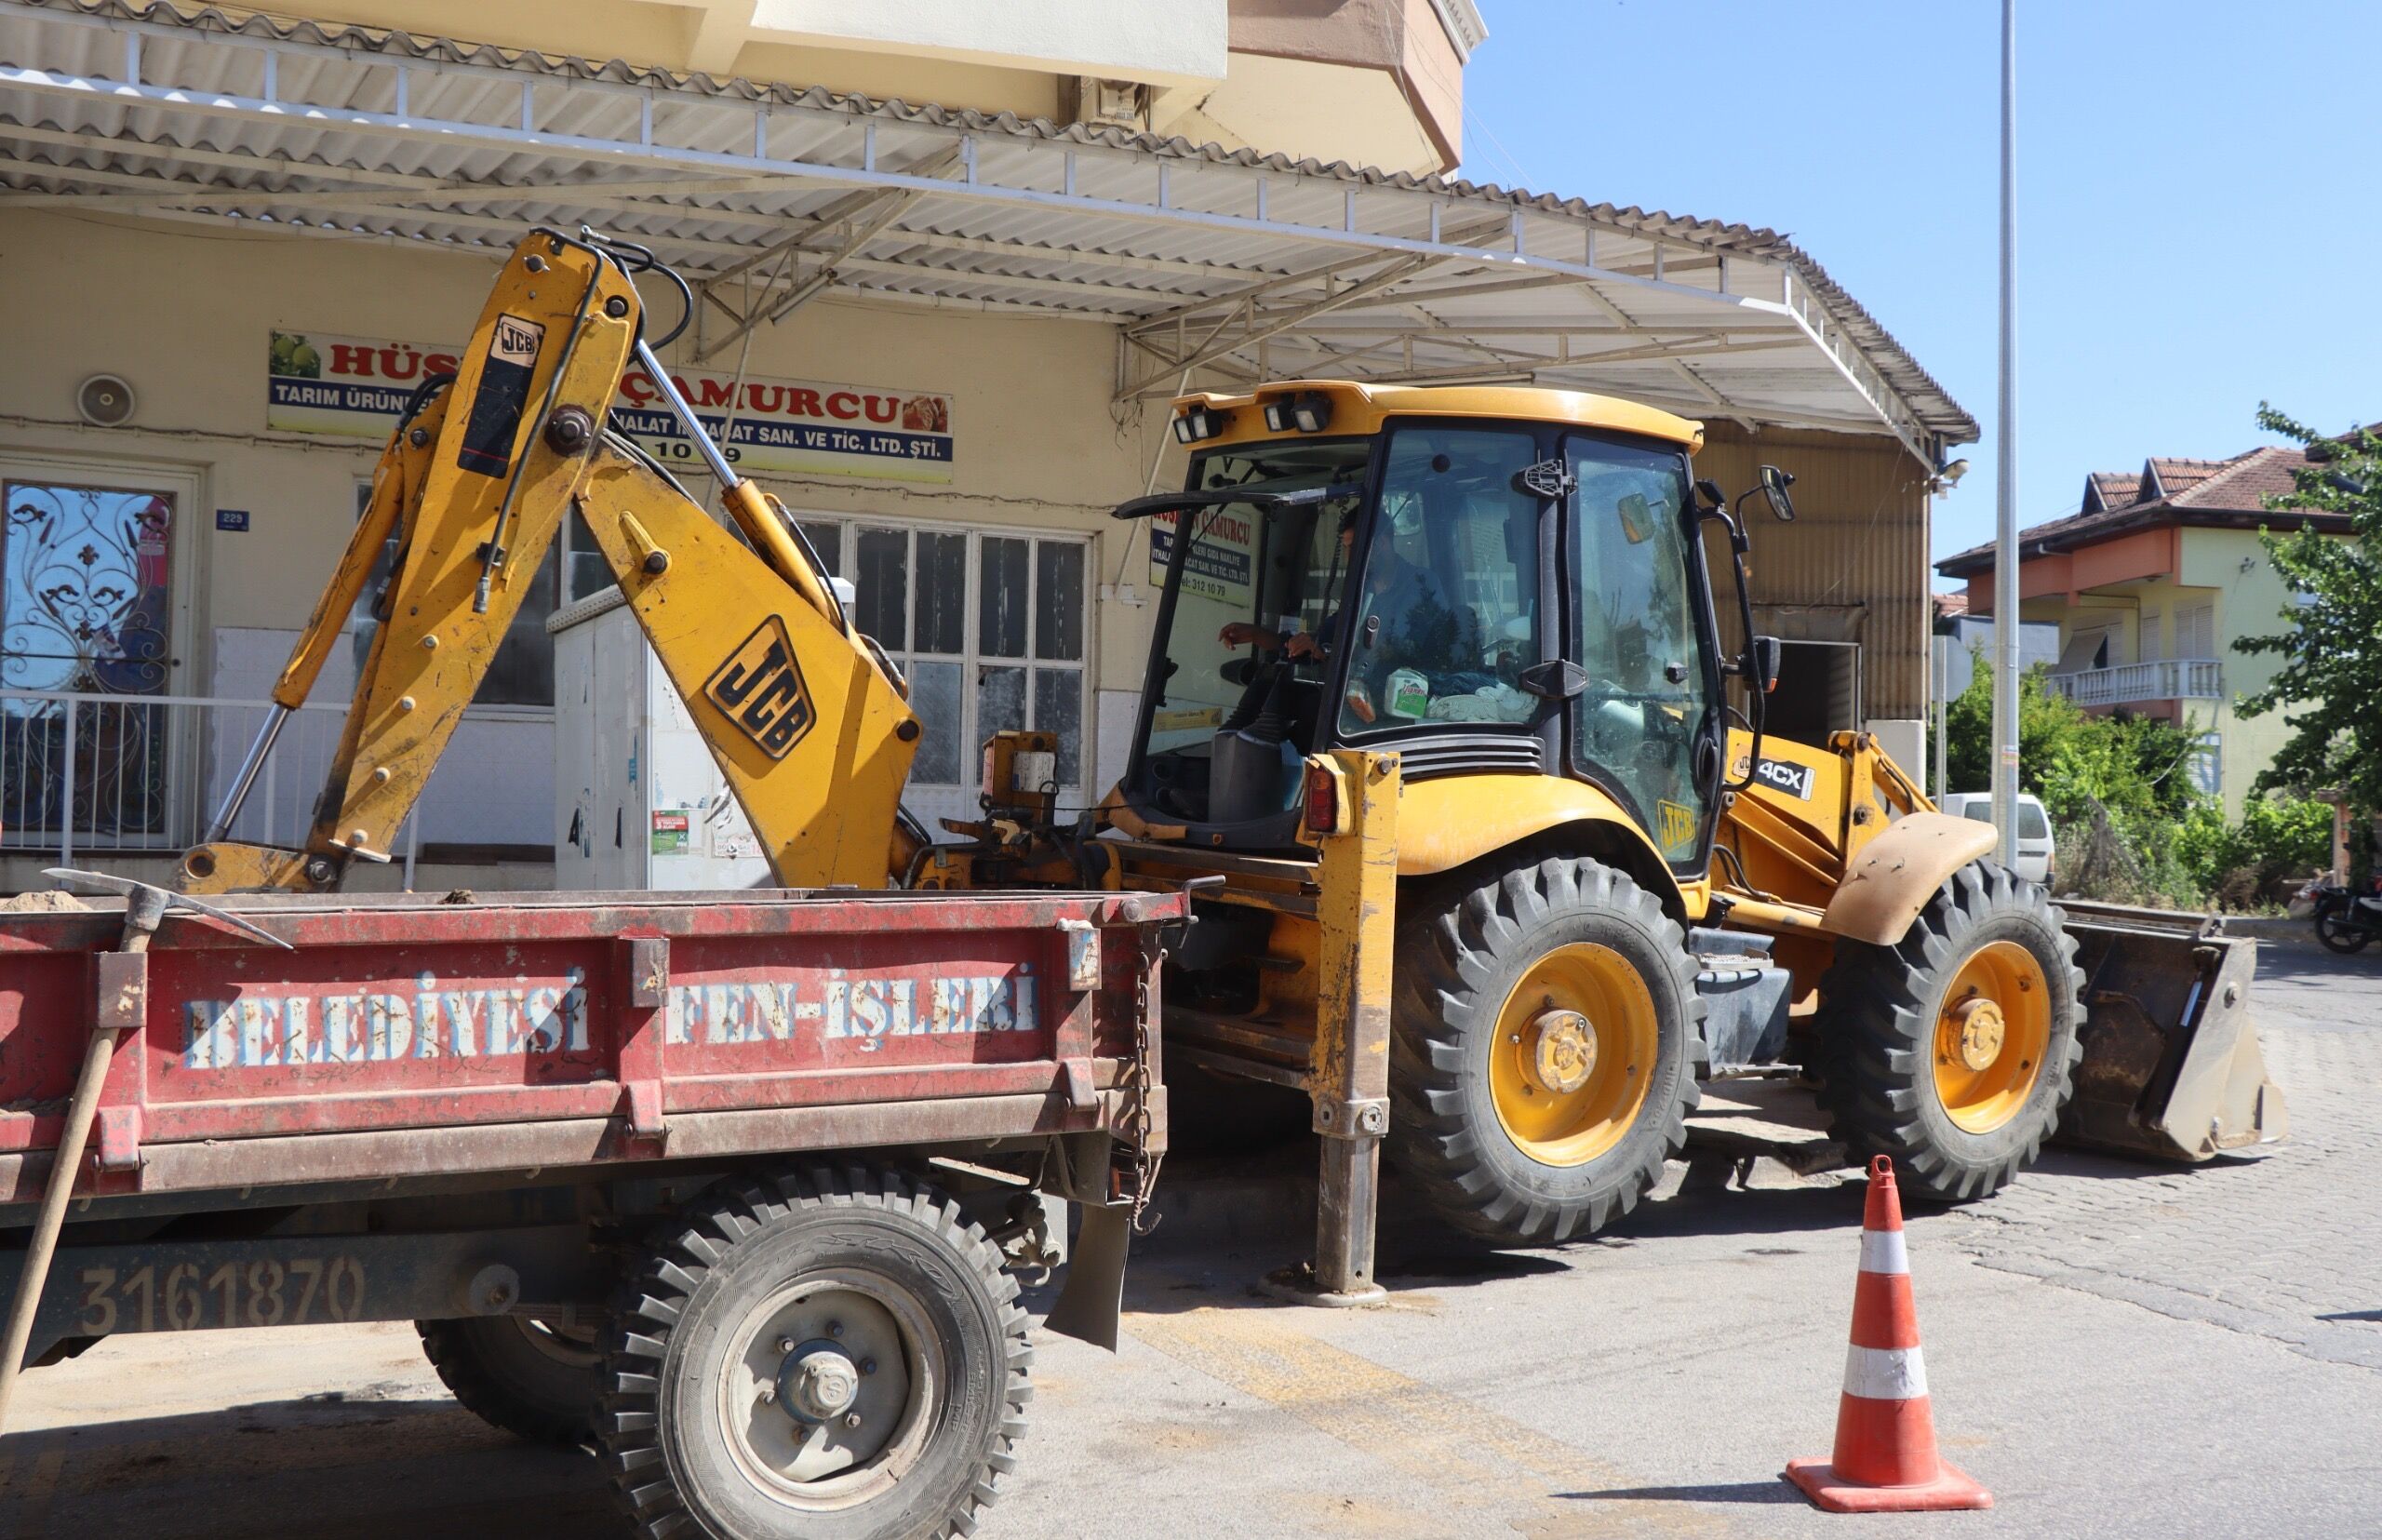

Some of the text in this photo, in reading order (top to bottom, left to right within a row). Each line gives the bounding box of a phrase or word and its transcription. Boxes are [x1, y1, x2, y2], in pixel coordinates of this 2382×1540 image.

[502, 327, 533, 352] JCB
[328, 342, 901, 423] HÜS ÇAMURCU
[275, 384, 340, 408] TARIM
[758, 430, 798, 446] SAN.
[805, 433, 826, 448] VE
[833, 430, 865, 451] TİC.
[870, 436, 904, 455] LTD.
[910, 439, 942, 459] ŞTİ.
[655, 442, 691, 459] 10
[1192, 578, 1205, 592] 312
[1207, 583, 1216, 595] 10
[1211, 563, 1218, 574] VE
[716, 638, 809, 751] JCB
[1759, 761, 1803, 790] 4CX
[1662, 805, 1694, 847] JCB
[182, 962, 1040, 1069] BELEDİYESİ FEN-İŞLERİ
[79, 1255, 366, 1336] 3161870
